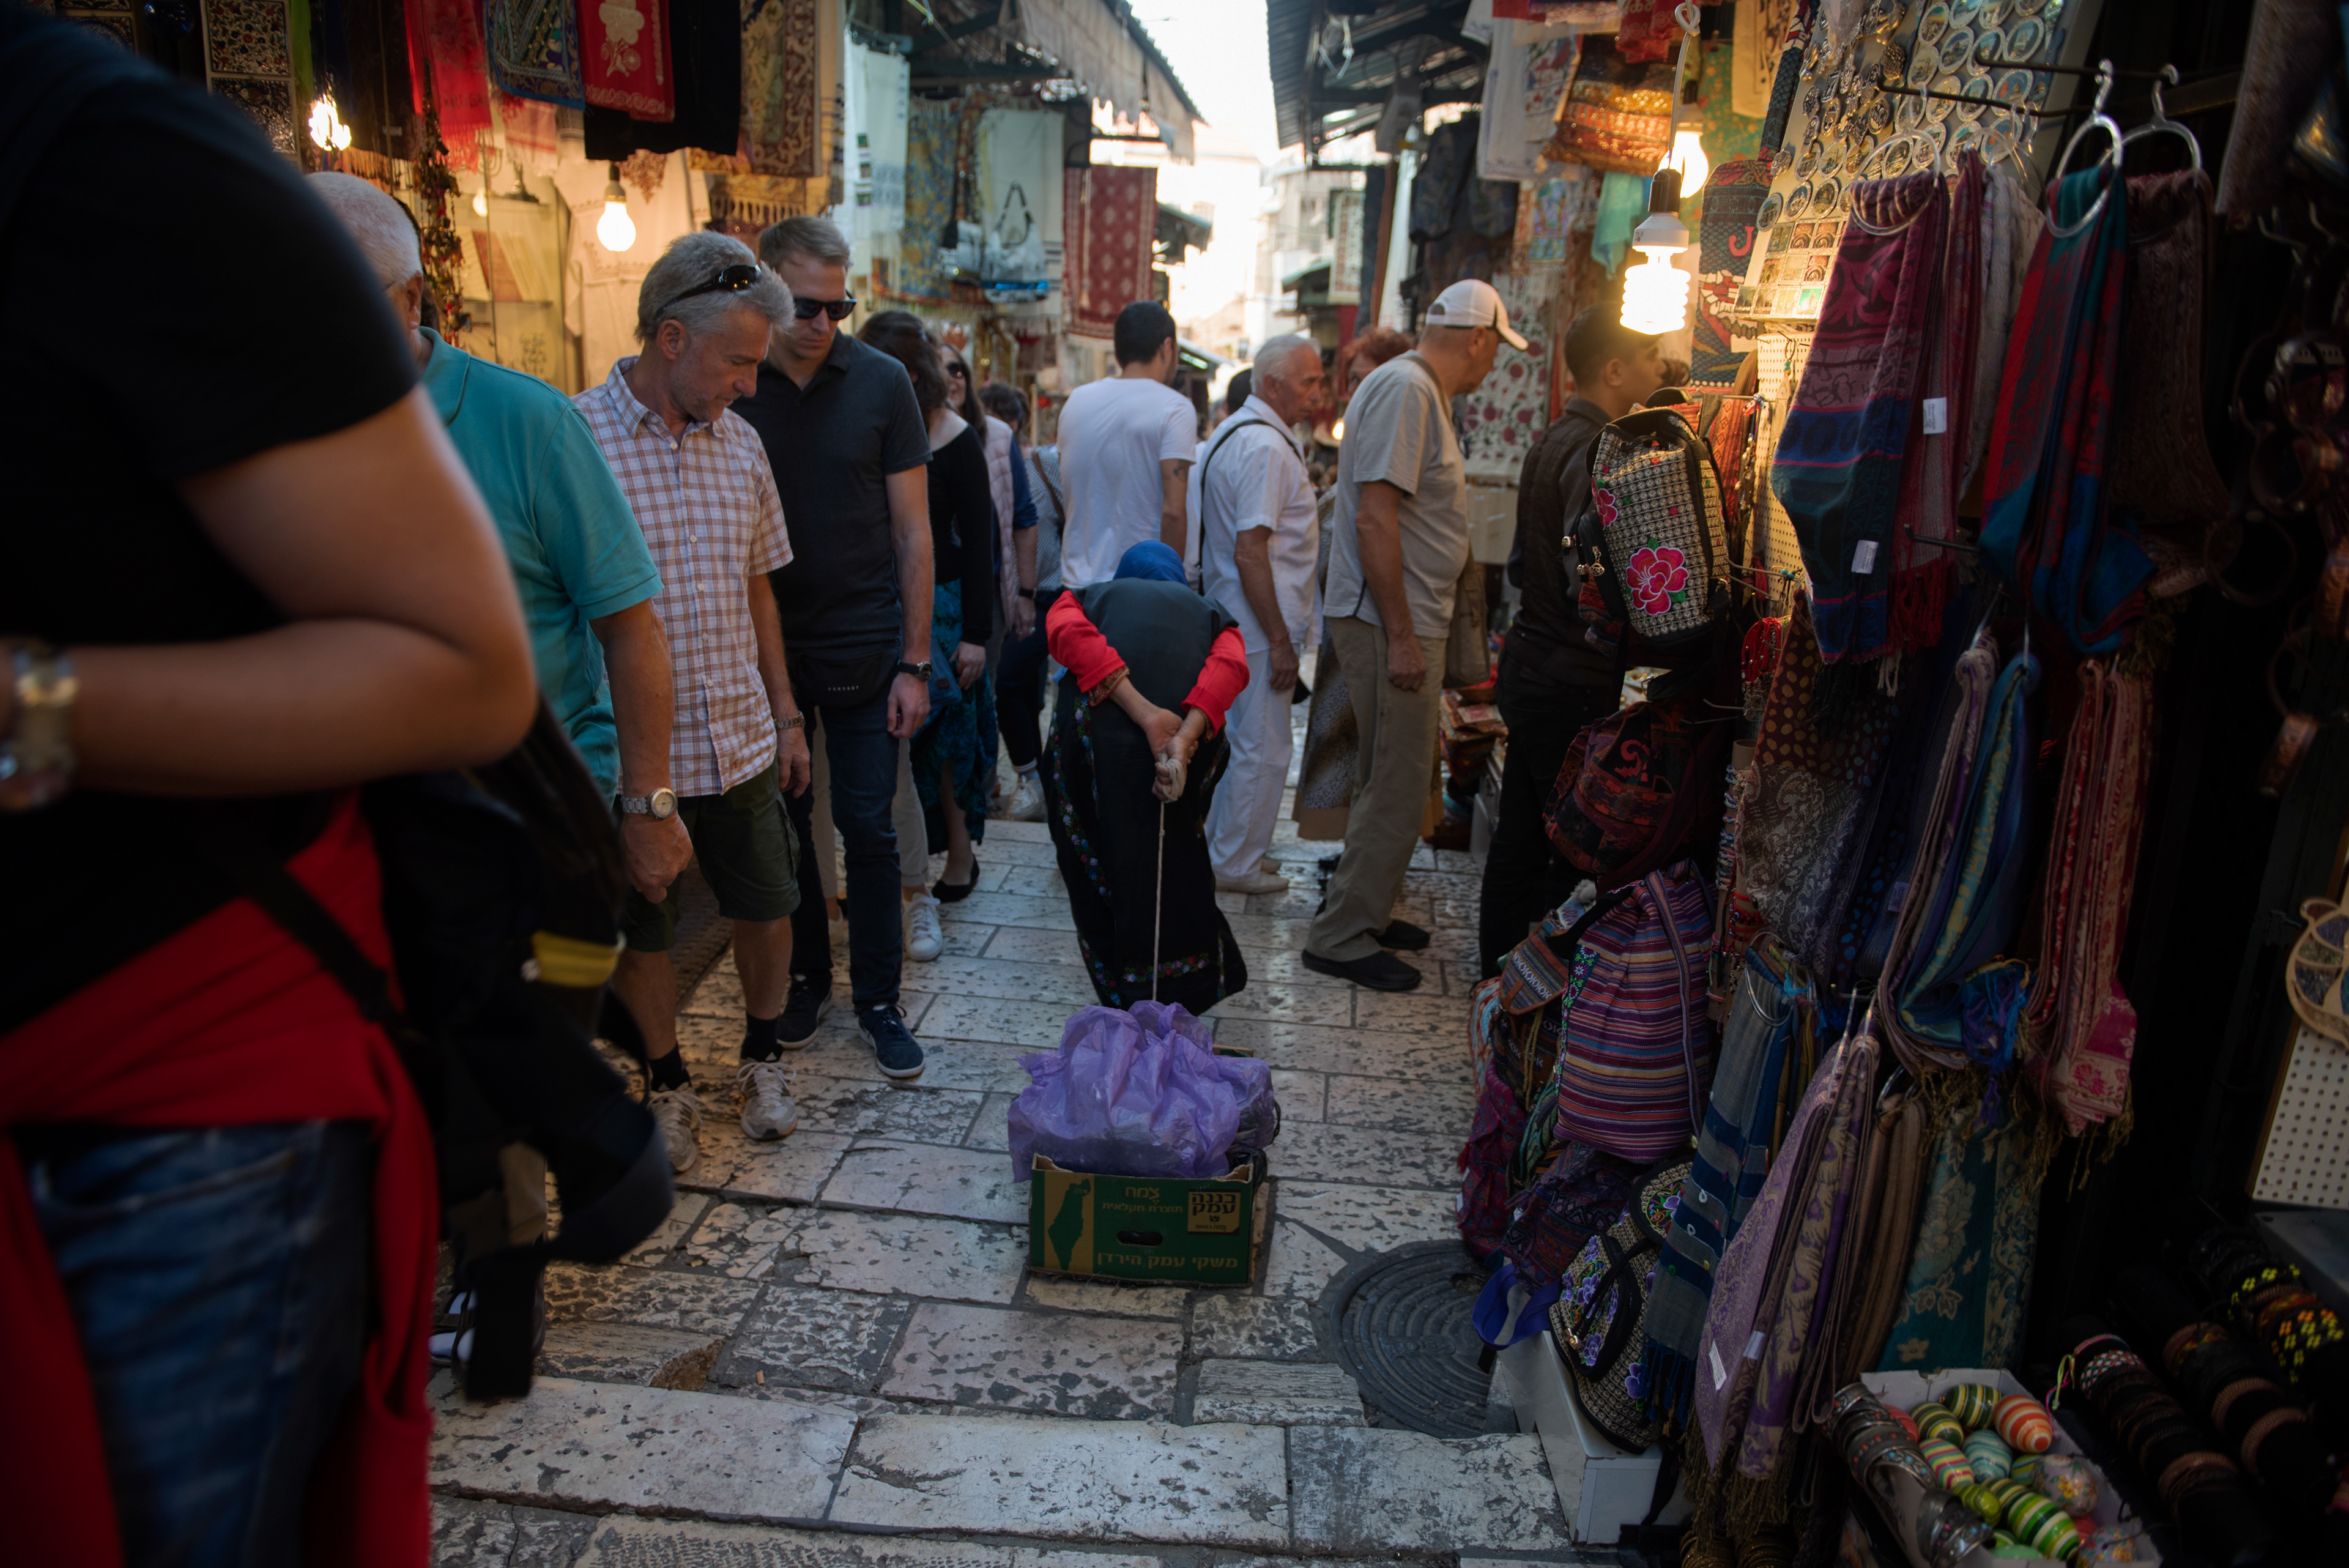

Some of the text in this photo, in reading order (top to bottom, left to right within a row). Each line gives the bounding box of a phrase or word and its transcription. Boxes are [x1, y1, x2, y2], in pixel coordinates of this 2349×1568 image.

[1192, 1193, 1236, 1203] בננה
[1101, 1202, 1145, 1214] חקלאית
[1192, 1203, 1236, 1216] עמק
[1097, 1252, 1238, 1270] משקי עמק הירדן
